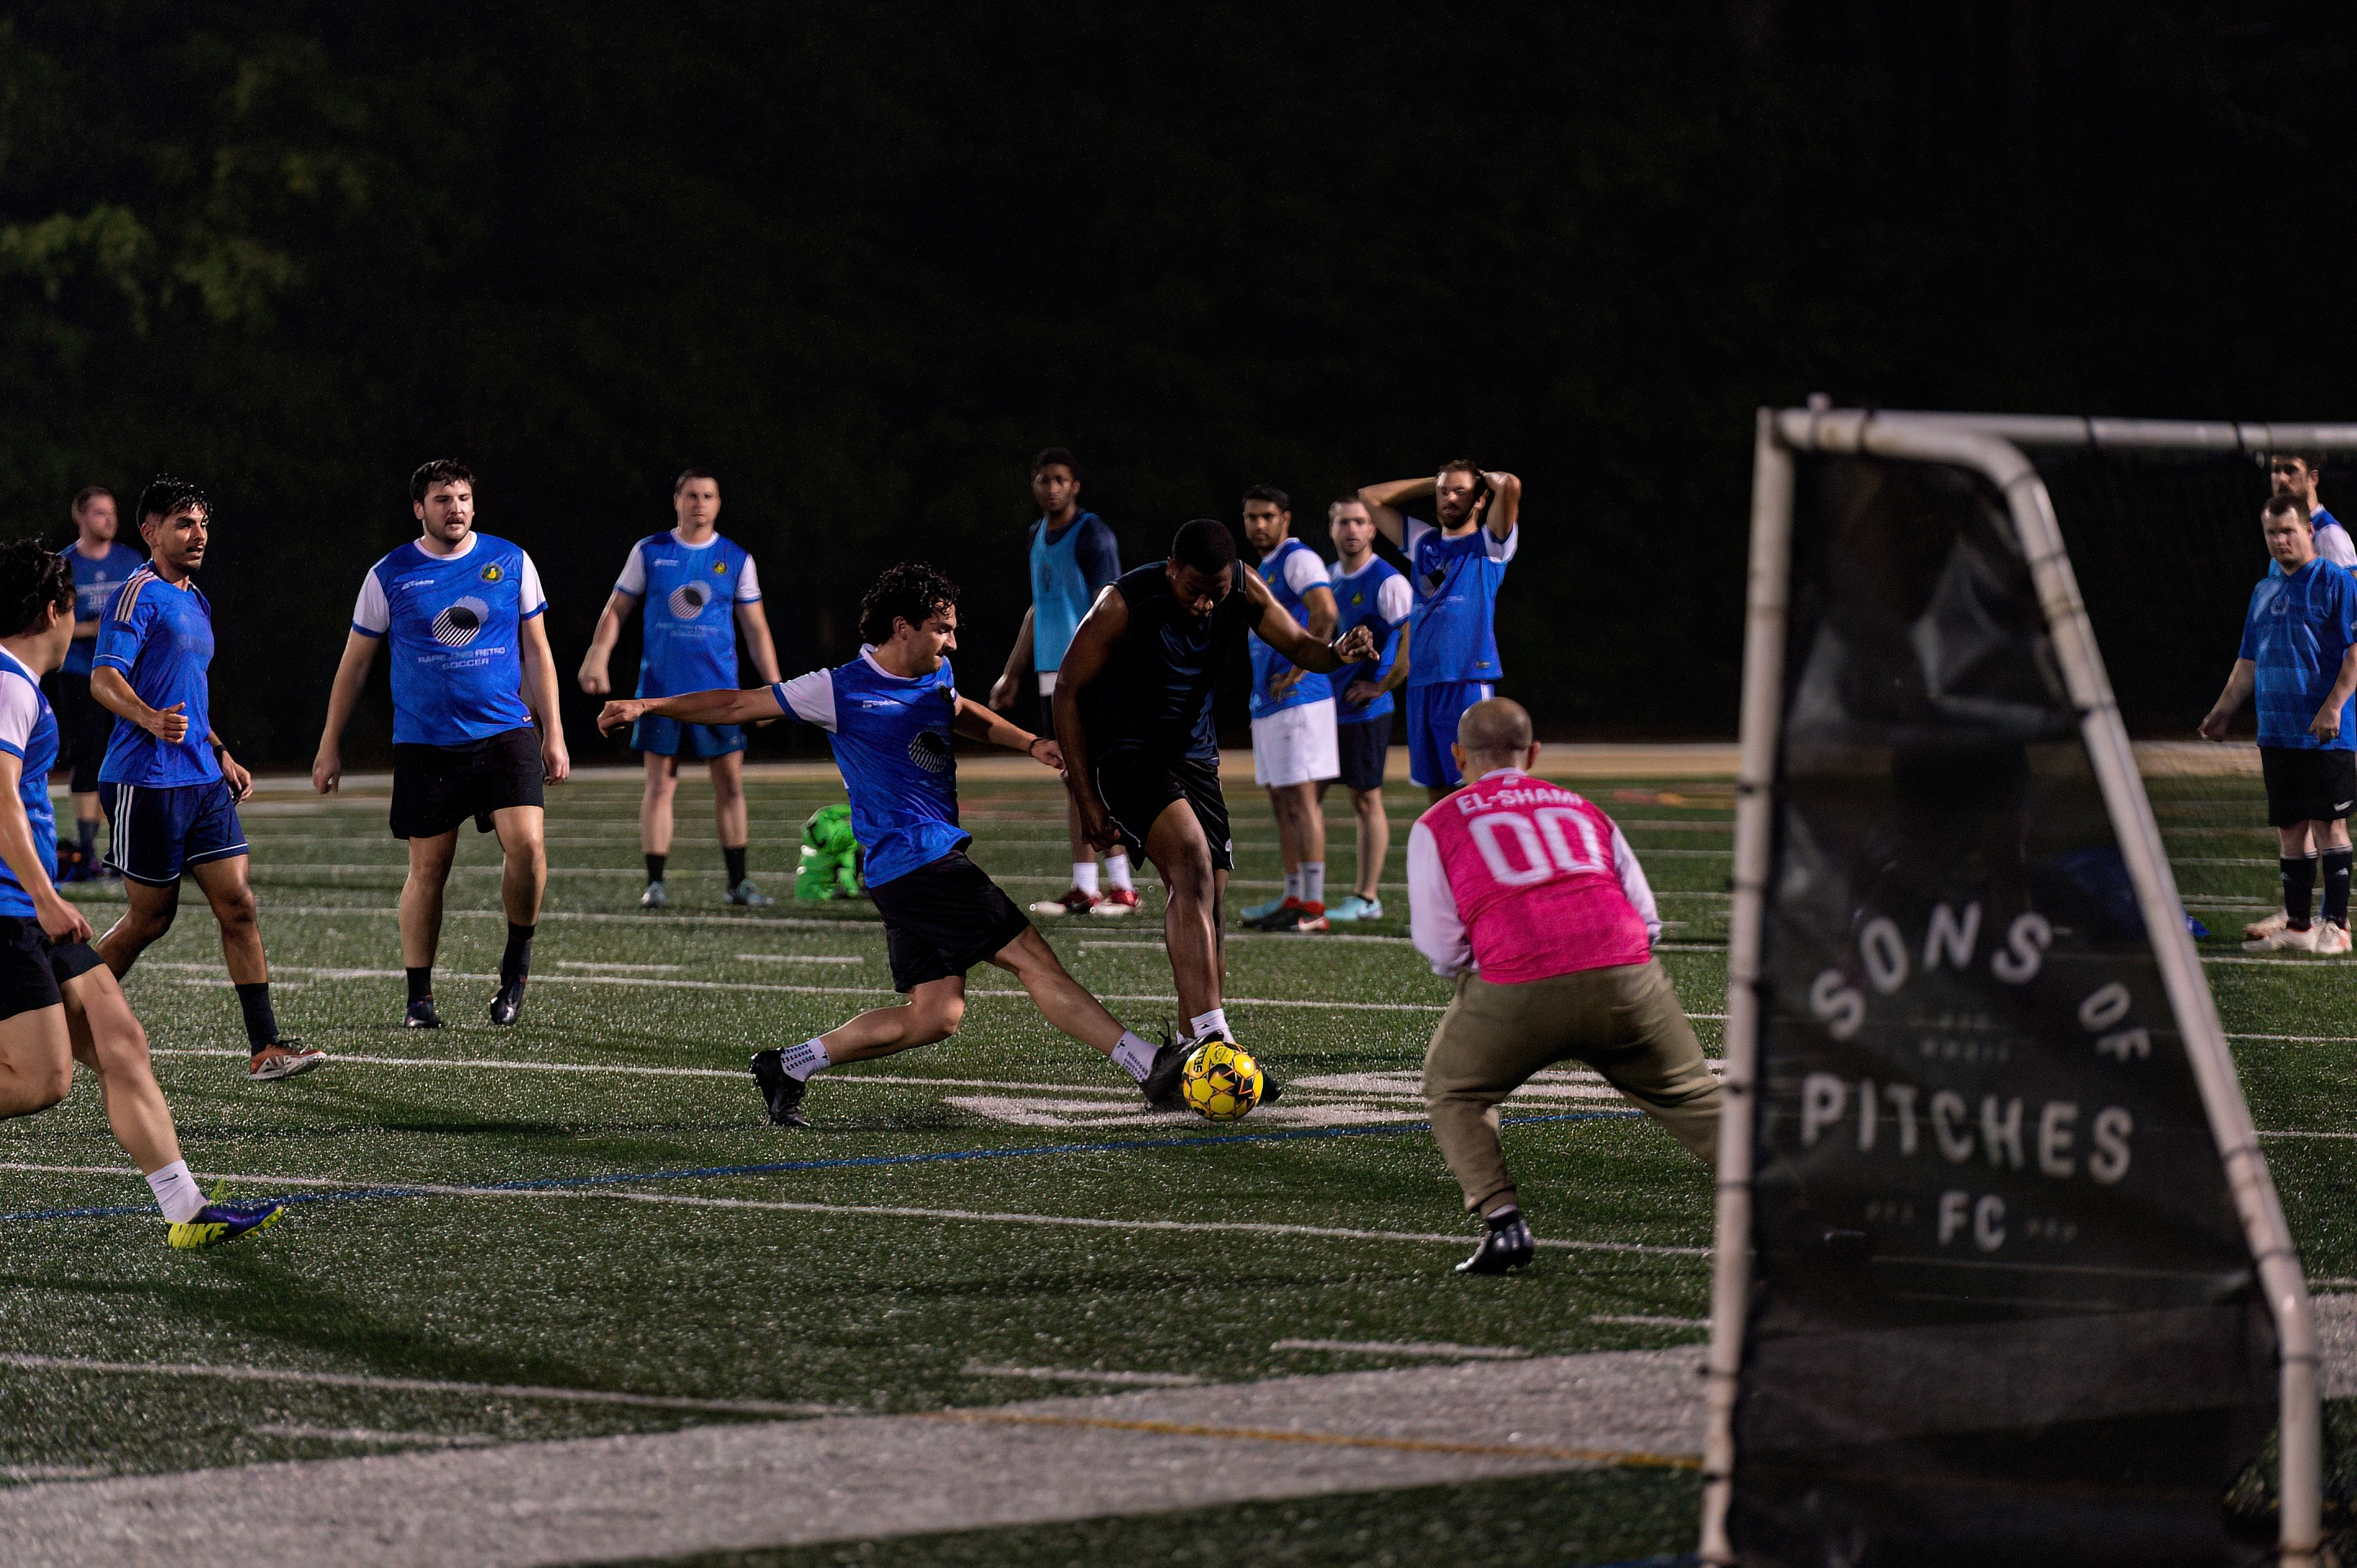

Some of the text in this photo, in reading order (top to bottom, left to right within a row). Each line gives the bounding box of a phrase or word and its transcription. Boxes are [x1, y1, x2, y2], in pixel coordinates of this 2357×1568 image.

[1468, 807, 1607, 885] 00
[1809, 902, 2152, 1062] SONS OF
[1802, 1072, 2134, 1185] PITCHES
[1936, 1188, 2008, 1252] FC
